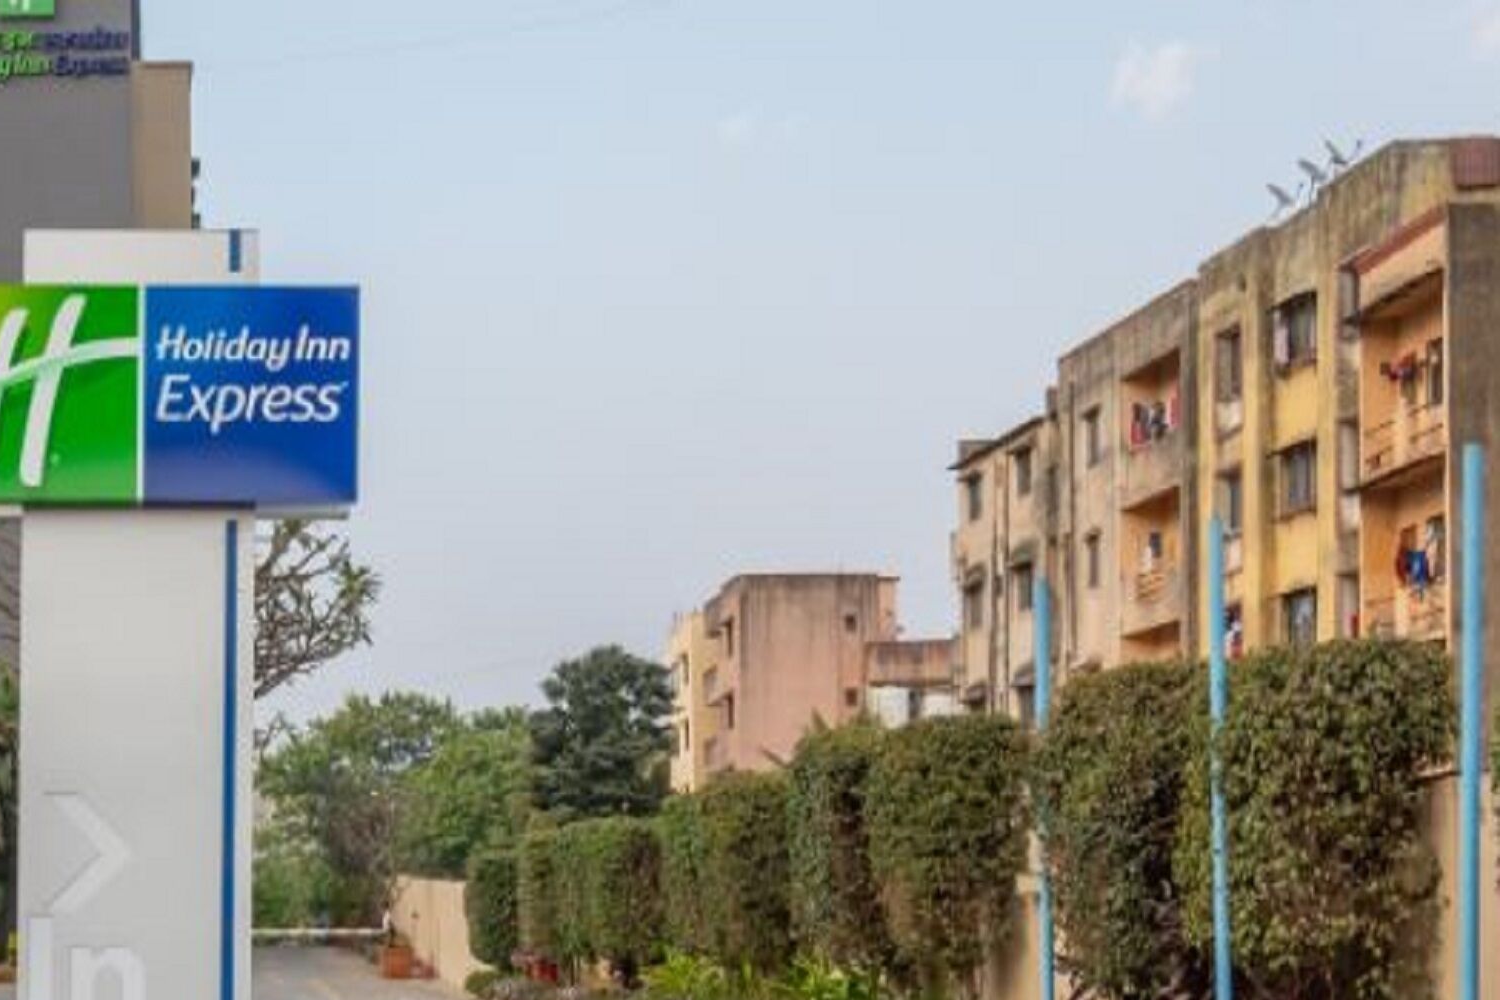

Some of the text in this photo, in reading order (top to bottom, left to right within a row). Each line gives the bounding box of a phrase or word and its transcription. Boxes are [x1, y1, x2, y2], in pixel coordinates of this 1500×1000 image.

[155, 324, 351, 372] Holiday Inn
[155, 374, 343, 435] Express
